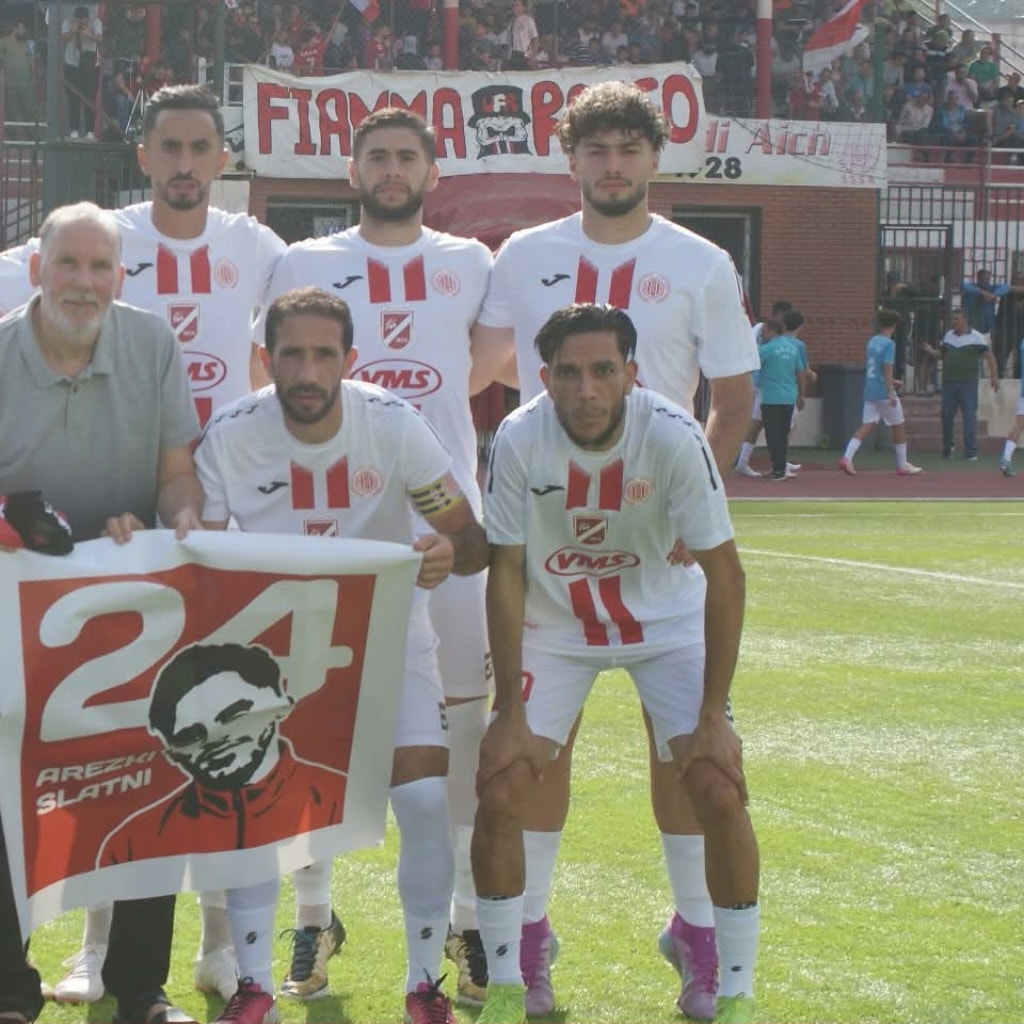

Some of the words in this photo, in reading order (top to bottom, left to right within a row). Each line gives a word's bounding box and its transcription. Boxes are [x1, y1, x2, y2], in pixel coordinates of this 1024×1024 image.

[676, 156, 743, 180] 28
[361, 369, 430, 389] VMS
[556, 552, 627, 570] VMS
[39, 578, 354, 743] 24
[35, 750, 157, 788] AREZKI
[35, 767, 153, 816] SLATNI
